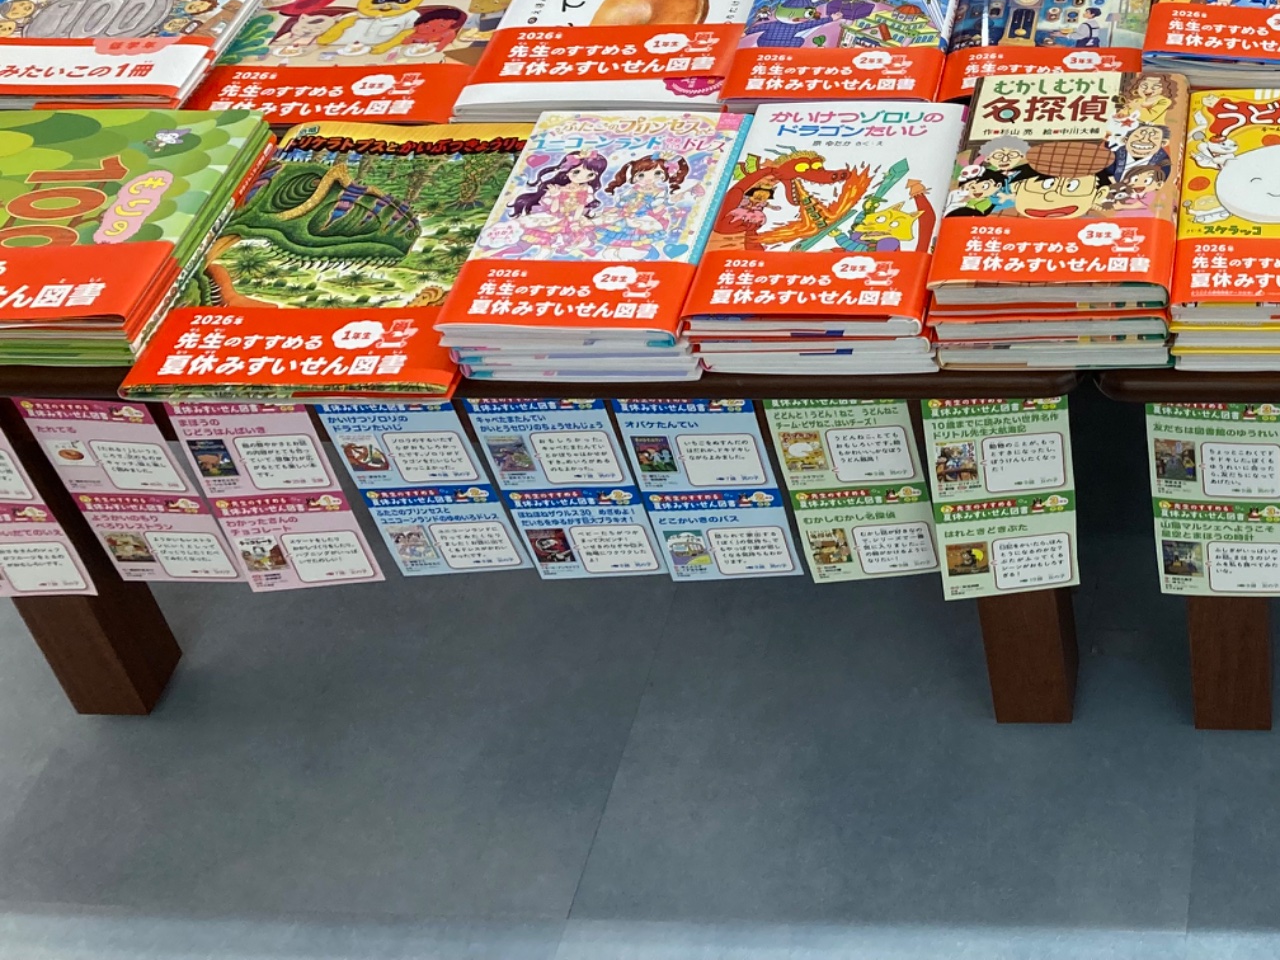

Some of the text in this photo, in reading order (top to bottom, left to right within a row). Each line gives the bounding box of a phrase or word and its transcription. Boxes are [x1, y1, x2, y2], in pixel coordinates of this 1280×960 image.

[1168, 20, 1270, 37] 先生のすすめる
[508, 44, 638, 59] 先生のすすめる
[499, 56, 715, 76] 夏休みすいせん図書
[751, 63, 854, 76] 先生のすすめる
[220, 84, 344, 98] 先生のすすめる
[744, 75, 916, 92] 夏休みすいせん図書
[993, 79, 1109, 95] むかしむかし
[209, 98, 414, 117] 夏休みすいせん図書
[982, 95, 1110, 124] 名探偵
[769, 110, 944, 126] かいけつゾロリの
[561, 118, 716, 136] ふたごのプリンセスと
[776, 124, 928, 138] ドラゴンたいじ
[1203, 225, 1261, 235] スケラッコ
[965, 240, 1079, 254] 先生のすすめる
[960, 256, 1150, 273] 夏休みすいせん図書
[717, 271, 832, 288] 先生のすすめる
[478, 280, 591, 298] 先生のすすめる
[710, 289, 903, 307] 夏休みすいせん図書
[467, 300, 659, 320] 夏休みすいせん図書
[175, 332, 323, 350] 先生のすすめる
[157, 355, 407, 376] 夏休みすいせん図書
[178, 418, 218, 427] まほうの
[327, 415, 408, 424] かいけつゾロリの
[475, 415, 547, 423] キャベたまたんてい
[624, 420, 699, 429] オバケたんてい
[182, 426, 266, 437] じどうはんばいき
[332, 423, 404, 432] ドラゴンたいじ
[480, 422, 604, 432] かいとうセロリのちょうせんじょう
[1152, 423, 1279, 438] 友だちは図書館のゆうれい
[225, 516, 299, 526] わかったさんの
[658, 514, 740, 525] どこかいきのバス
[803, 510, 897, 525] むかしむかし名探偵
[229, 524, 293, 534] チョコレート
[943, 523, 1029, 538] はれときどきぶた
